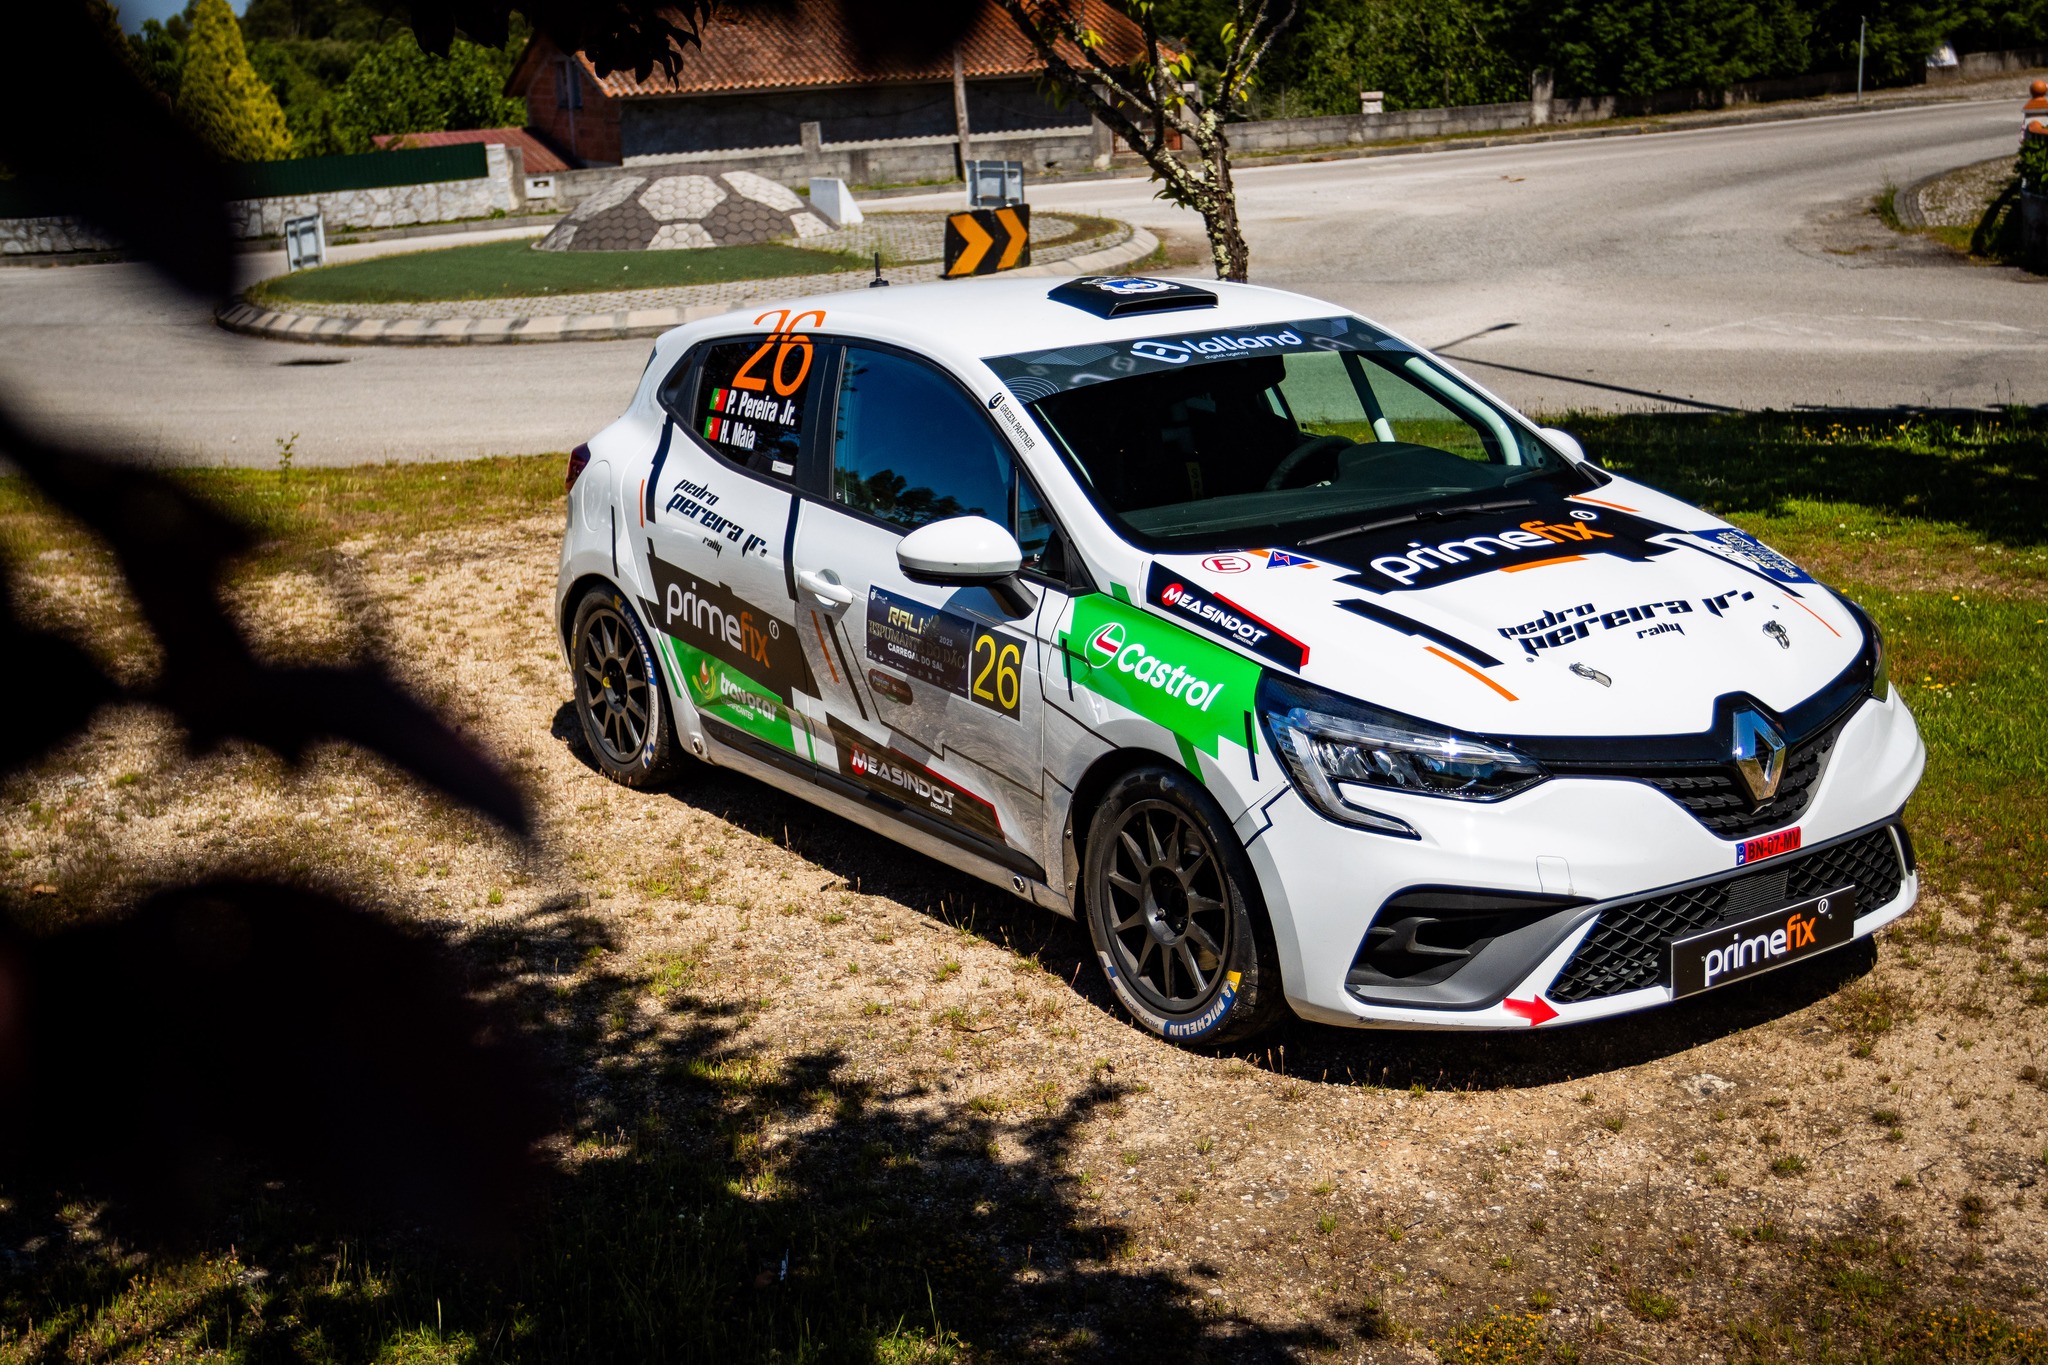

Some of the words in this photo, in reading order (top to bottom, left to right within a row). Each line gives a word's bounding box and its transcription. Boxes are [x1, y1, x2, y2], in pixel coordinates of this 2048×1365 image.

[731, 309, 827, 397] 26
[1181, 330, 1302, 354] lalland
[1204, 352, 1226, 360] digital
[1226, 351, 1250, 360] agency
[725, 389, 737, 415] P.
[737, 391, 779, 423] Pereira
[779, 399, 796, 426] Jr.
[719, 419, 730, 444] H.
[731, 421, 757, 450] Maia
[1000, 403, 1016, 426] GREEN
[1012, 421, 1036, 451] PARTNER
[673, 479, 720, 507] pedro
[666, 493, 745, 543] pereira
[702, 536, 723, 559] rally
[1370, 519, 1615, 586] primefix
[666, 581, 771, 669] primefix
[887, 605, 925, 635] RALI
[1161, 585, 1268, 643] MEASINDOT
[1497, 602, 1597, 640] pedro
[1518, 599, 1694, 657] pereira
[1636, 622, 1686, 640] rally
[625, 612, 655, 680] MICHELIN
[887, 642, 920, 663] CARREGAL
[920, 655, 931, 667] DO
[931, 660, 945, 673] SAL
[939, 635, 954, 647] 2025
[972, 633, 1021, 710] 26
[1117, 642, 1225, 713] Castrol
[851, 747, 955, 809] MEASINDOT
[1747, 829, 1800, 860] BN-07-MV
[1703, 913, 1817, 988] primefix
[1122, 994, 1141, 1016] SPORT
[1141, 1014, 1160, 1029] PILOT
[1168, 996, 1227, 1037] MICHELIN
